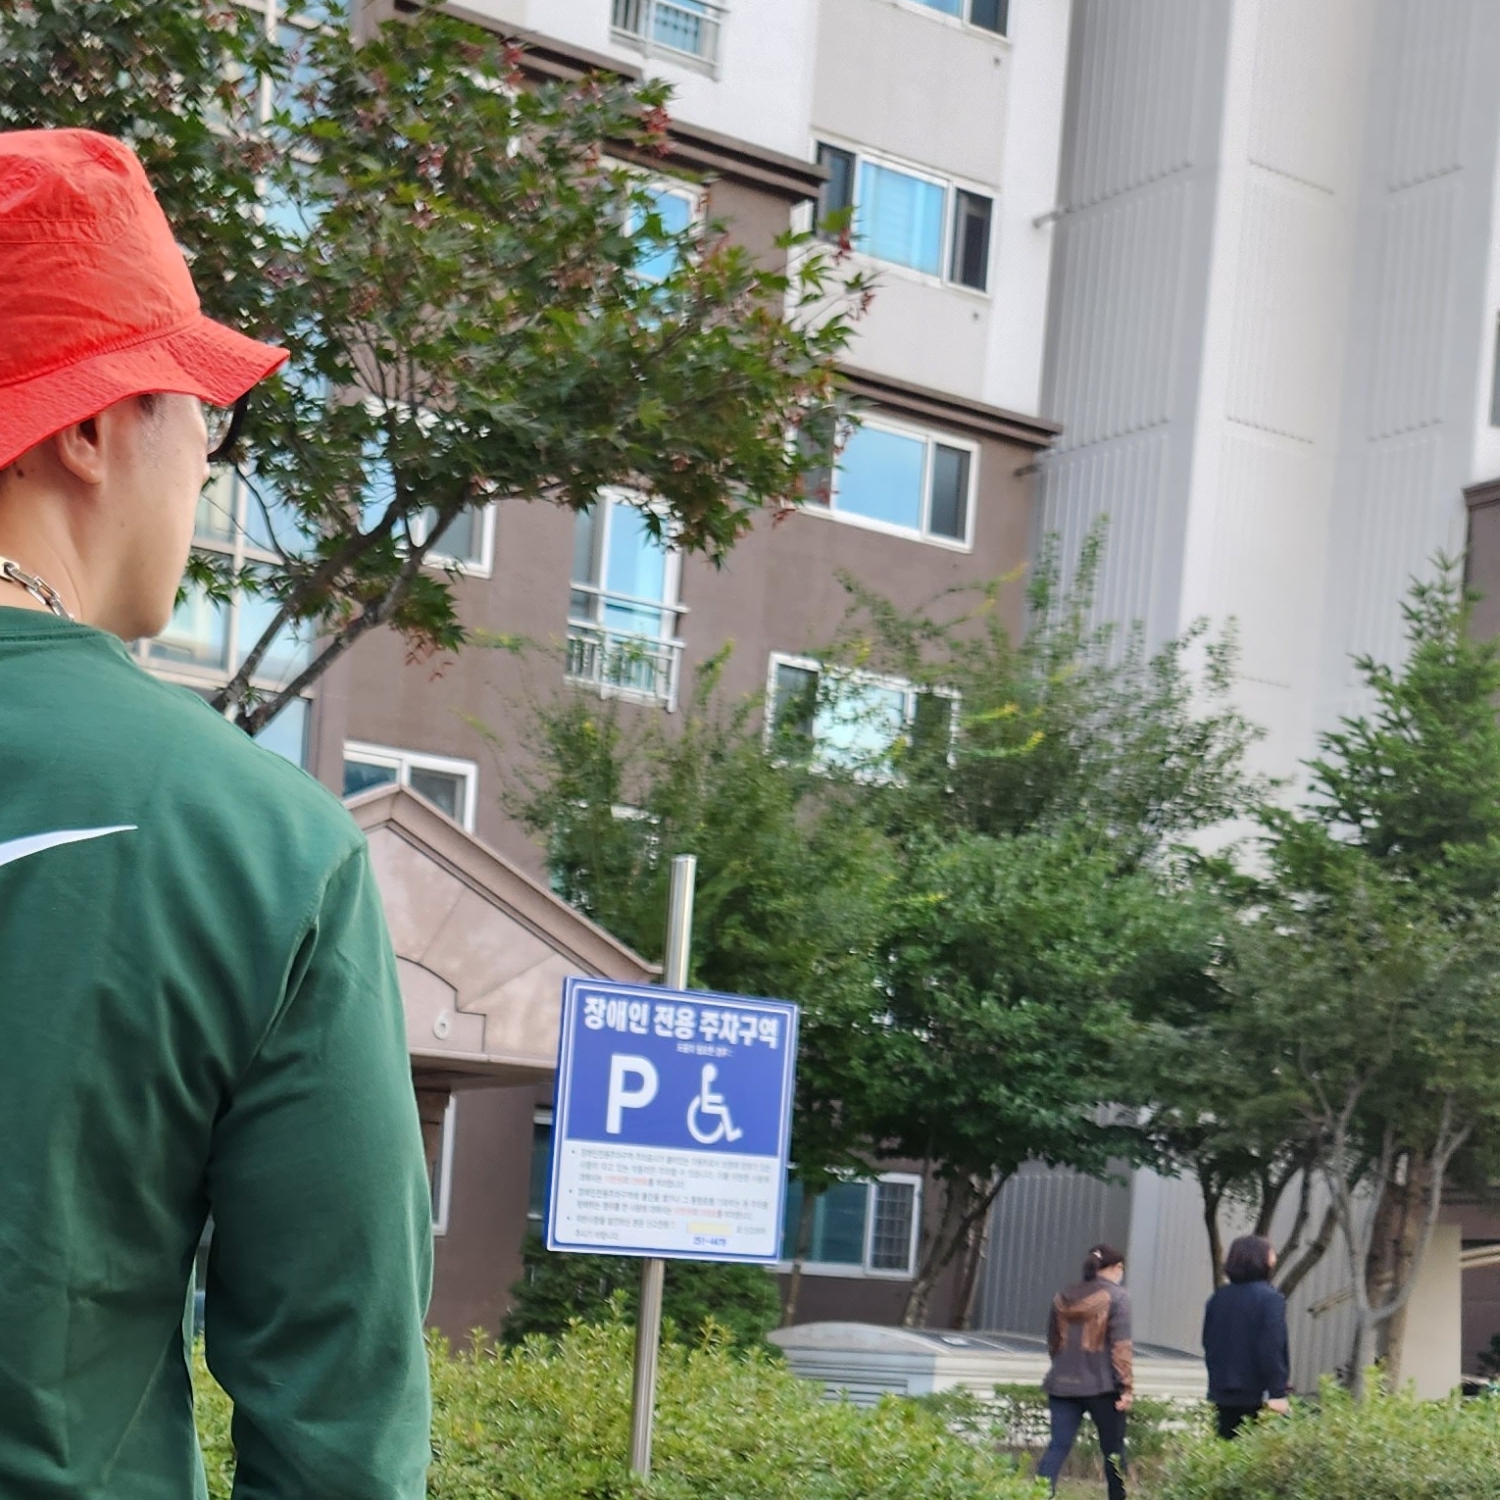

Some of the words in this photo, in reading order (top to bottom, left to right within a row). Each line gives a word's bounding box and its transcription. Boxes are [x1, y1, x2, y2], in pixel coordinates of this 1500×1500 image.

[584, 996, 650, 1035] 장애인
[654, 1003, 696, 1040] 전용
[699, 1010, 779, 1049] 주차구역
[605, 1053, 659, 1134] P
